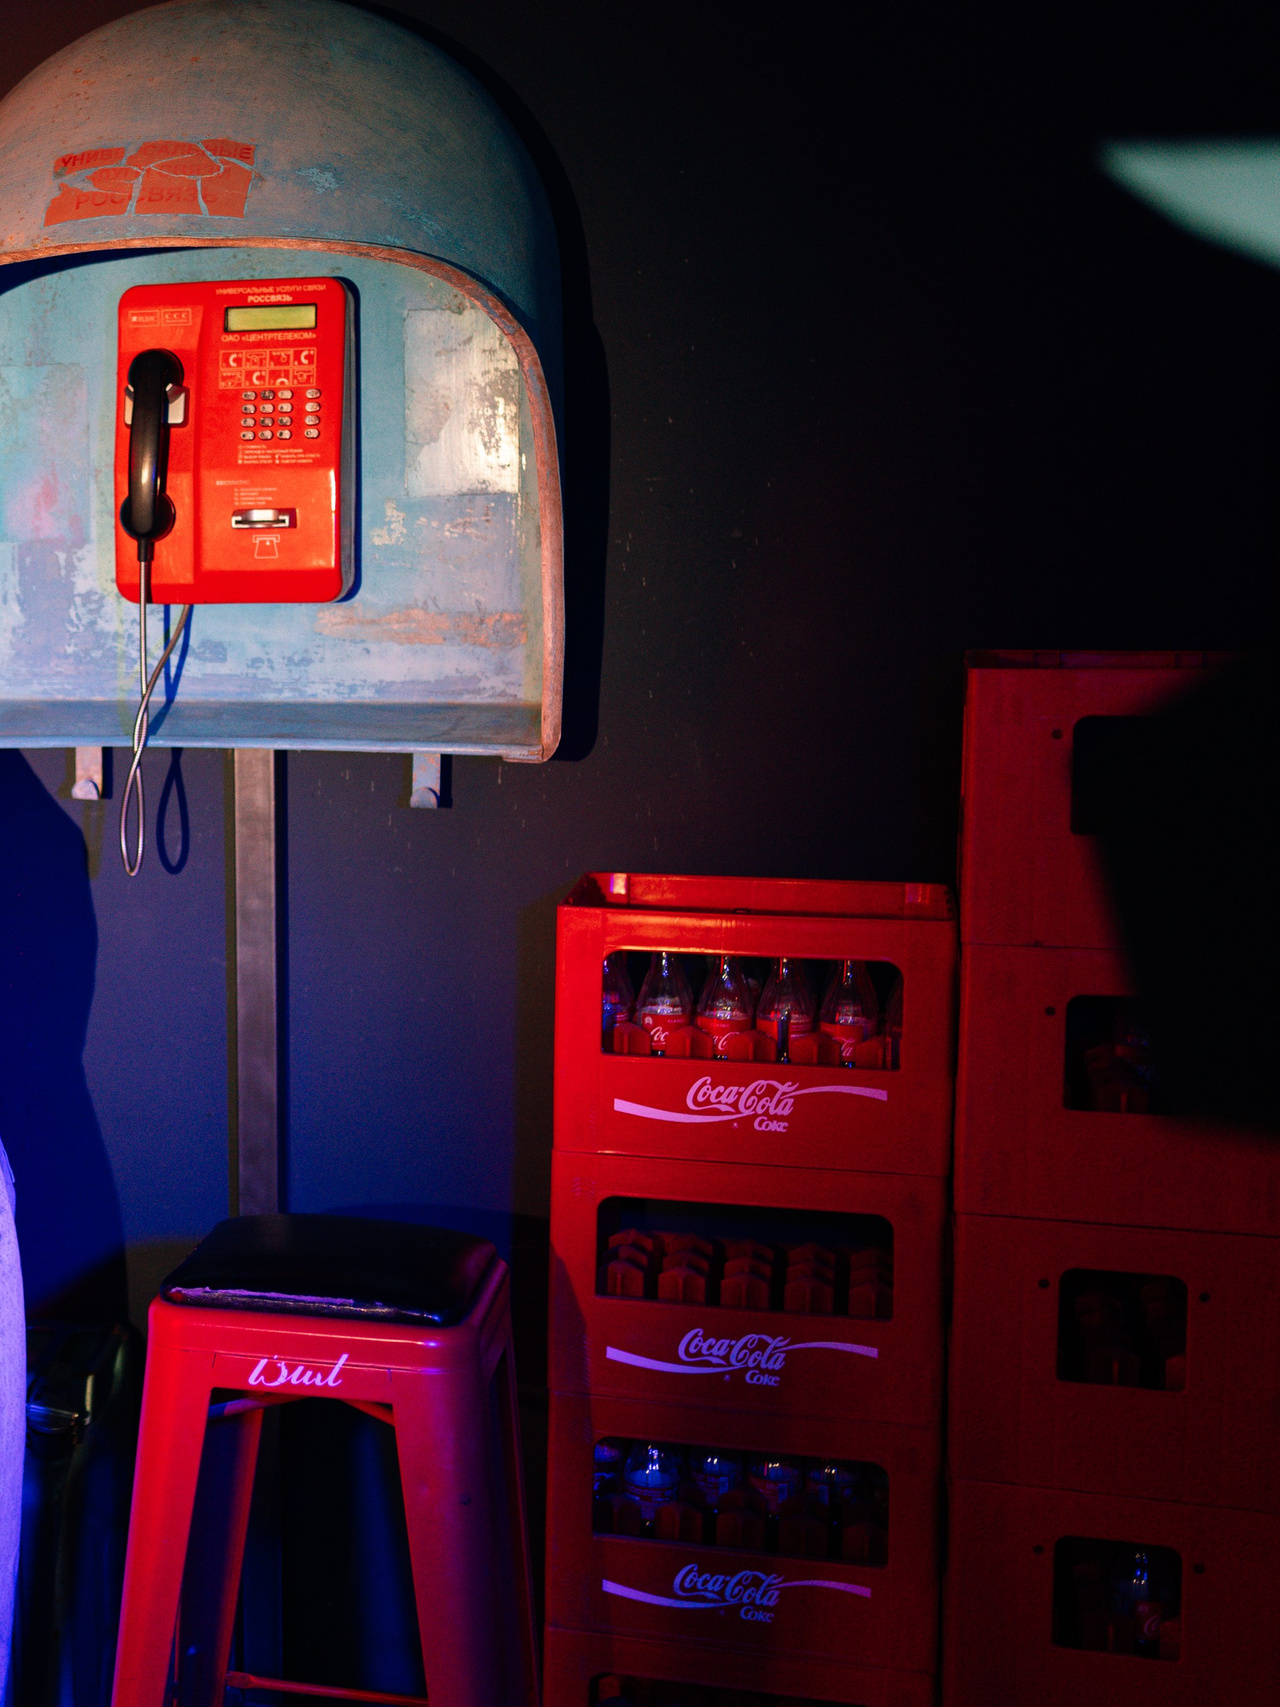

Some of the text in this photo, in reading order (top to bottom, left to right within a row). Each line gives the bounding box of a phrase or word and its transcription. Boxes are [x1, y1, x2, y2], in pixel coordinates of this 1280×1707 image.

[61, 143, 253, 167] УНИВЕСАЛЬНЫЕ
[215, 284, 327, 296] УНИВЕРСАЛЬНЫЕ УСЛУГИ СВЯЗИ
[247, 294, 293, 303] РОССВЯЗЬ
[221, 332, 317, 343] ОАО «ЦЕНТРТЕЛЕКОМ»
[686, 1076, 799, 1116] Coca-Cola
[753, 1116, 788, 1132] Coke
[678, 1328, 791, 1370] Coca-Cola
[745, 1369, 780, 1386] Coke
[673, 1563, 785, 1607] Coca-Cola
[740, 1605, 775, 1622] Coke
